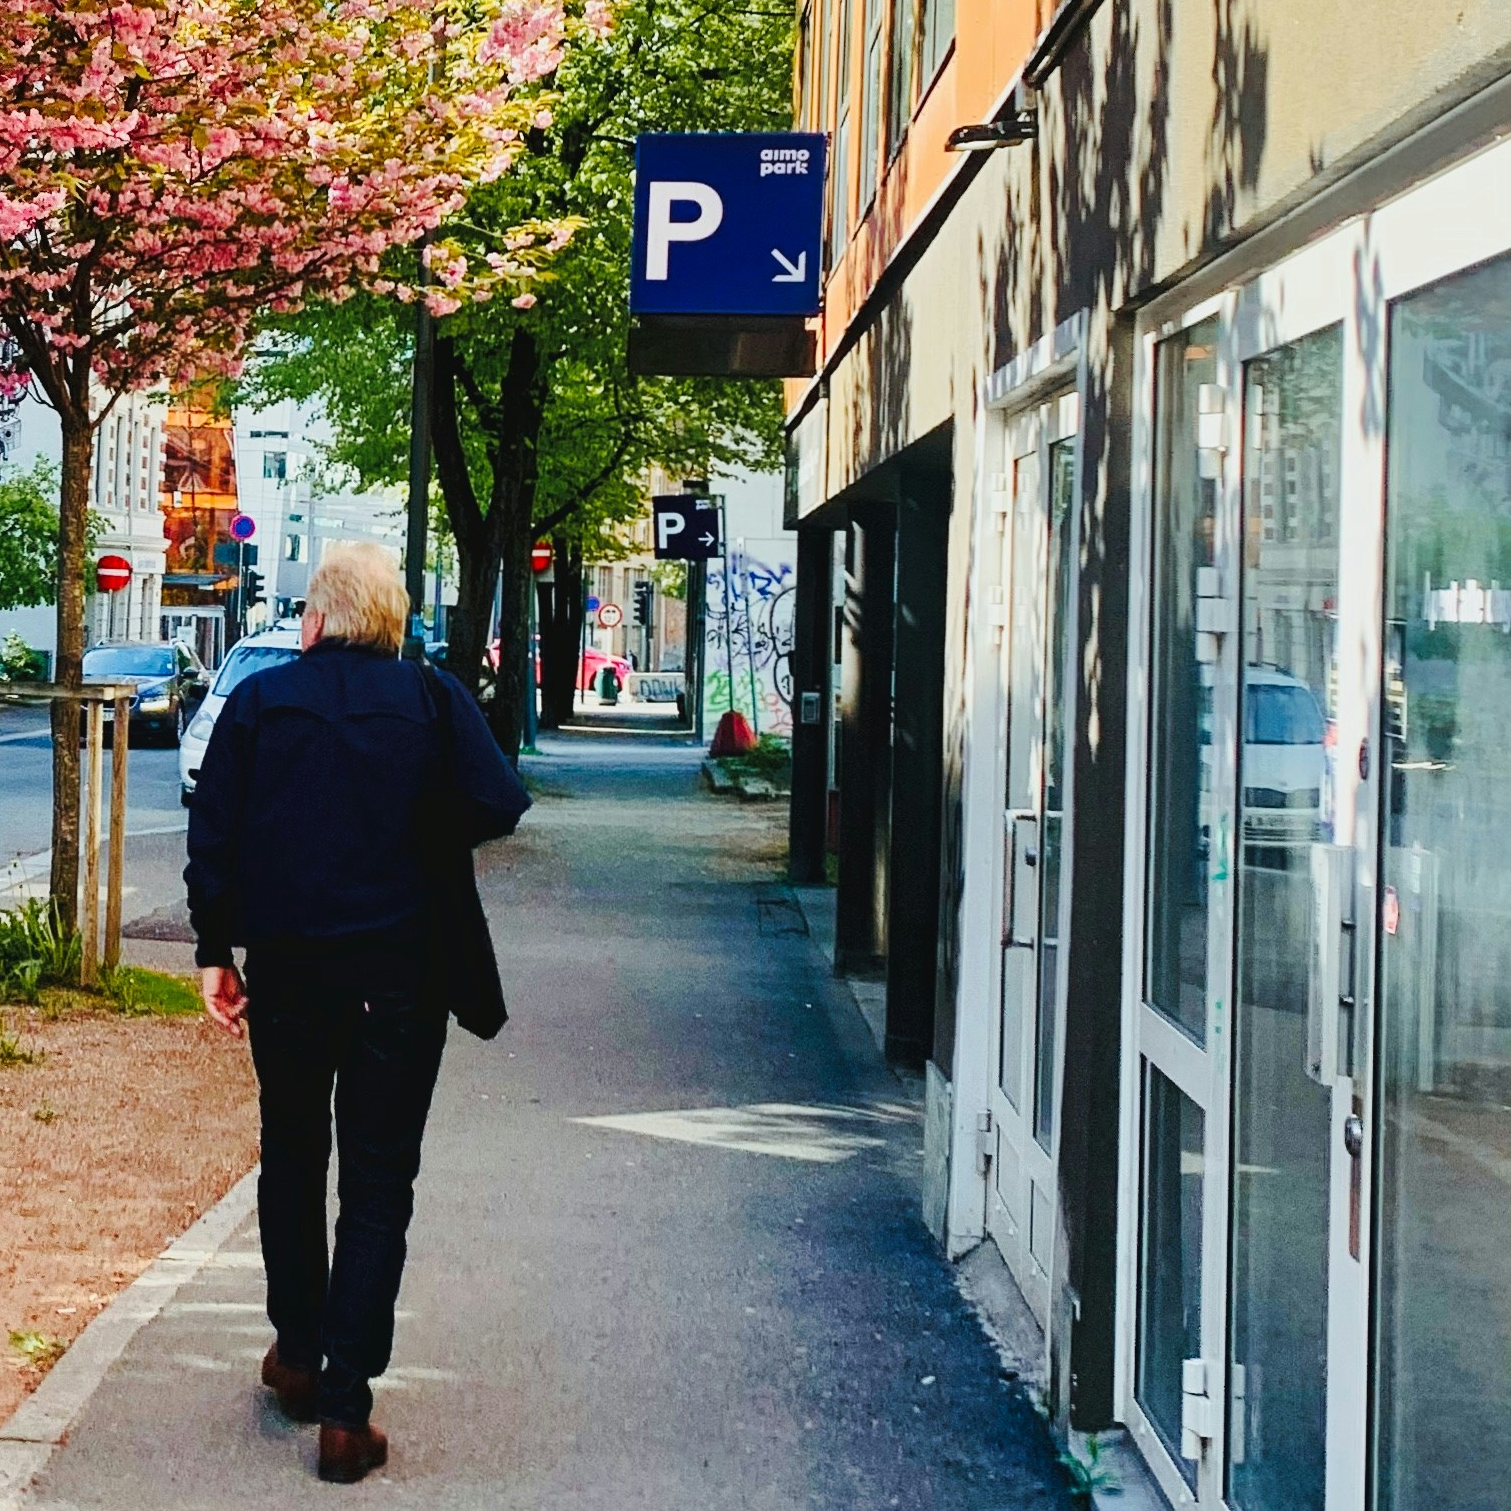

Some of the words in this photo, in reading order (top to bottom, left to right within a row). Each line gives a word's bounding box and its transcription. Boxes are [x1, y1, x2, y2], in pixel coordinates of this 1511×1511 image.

[760, 149, 810, 161] aimo
[760, 161, 808, 177] park
[645, 181, 723, 281] P
[658, 512, 685, 549] P
